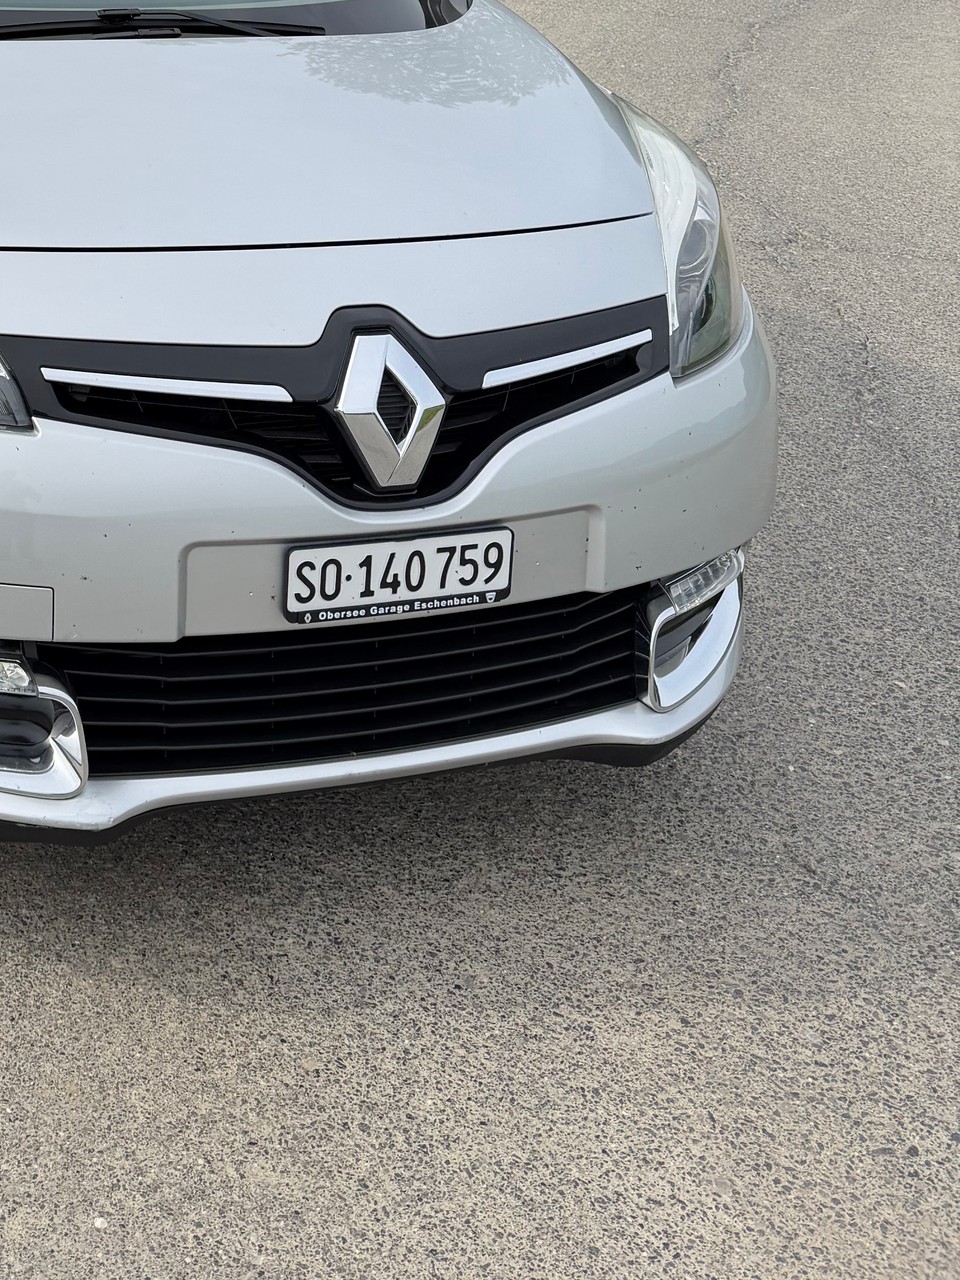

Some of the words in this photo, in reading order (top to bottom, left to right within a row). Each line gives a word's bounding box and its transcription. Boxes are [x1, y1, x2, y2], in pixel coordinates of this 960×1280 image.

[319, 609, 366, 620] Obersee
[370, 603, 410, 615] Garage
[414, 594, 480, 610] Eschenbach
